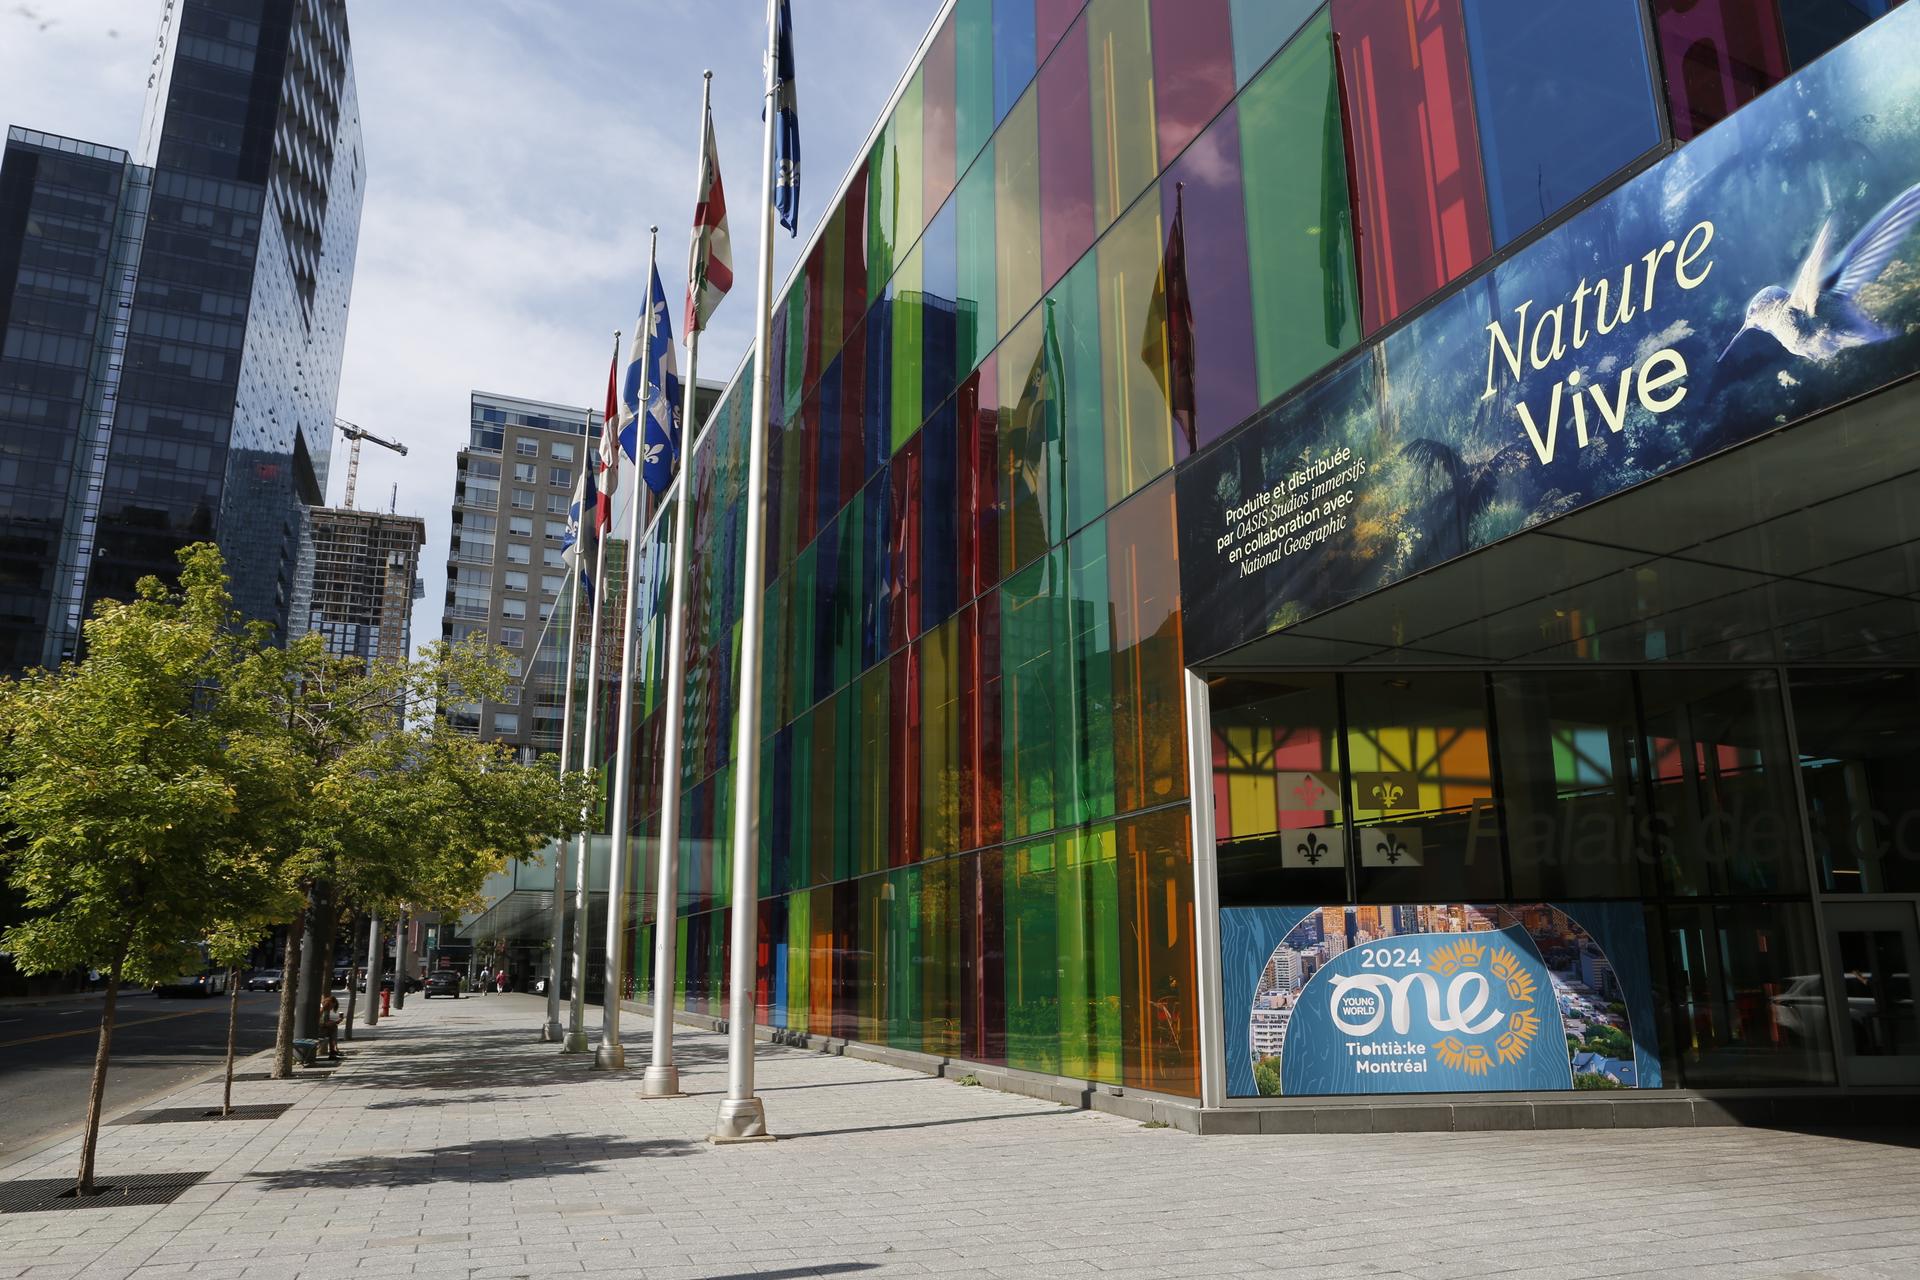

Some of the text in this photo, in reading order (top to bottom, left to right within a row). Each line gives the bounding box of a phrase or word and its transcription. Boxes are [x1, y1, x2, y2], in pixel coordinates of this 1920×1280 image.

[1481, 221, 1714, 400] Nature
[1515, 349, 1688, 465] Vive
[1217, 457, 1366, 554] par OASIS Studios immersifs
[1226, 447, 1351, 526] Produite et distribuée
[1229, 490, 1354, 563] en collaboration avec
[1240, 514, 1346, 578] National Geographic
[1361, 948, 1421, 967] 2024
[1343, 997, 1374, 1006] YOUNG
[1343, 1007, 1375, 1016] WORLD
[1356, 1059, 1427, 1073] Montréal
